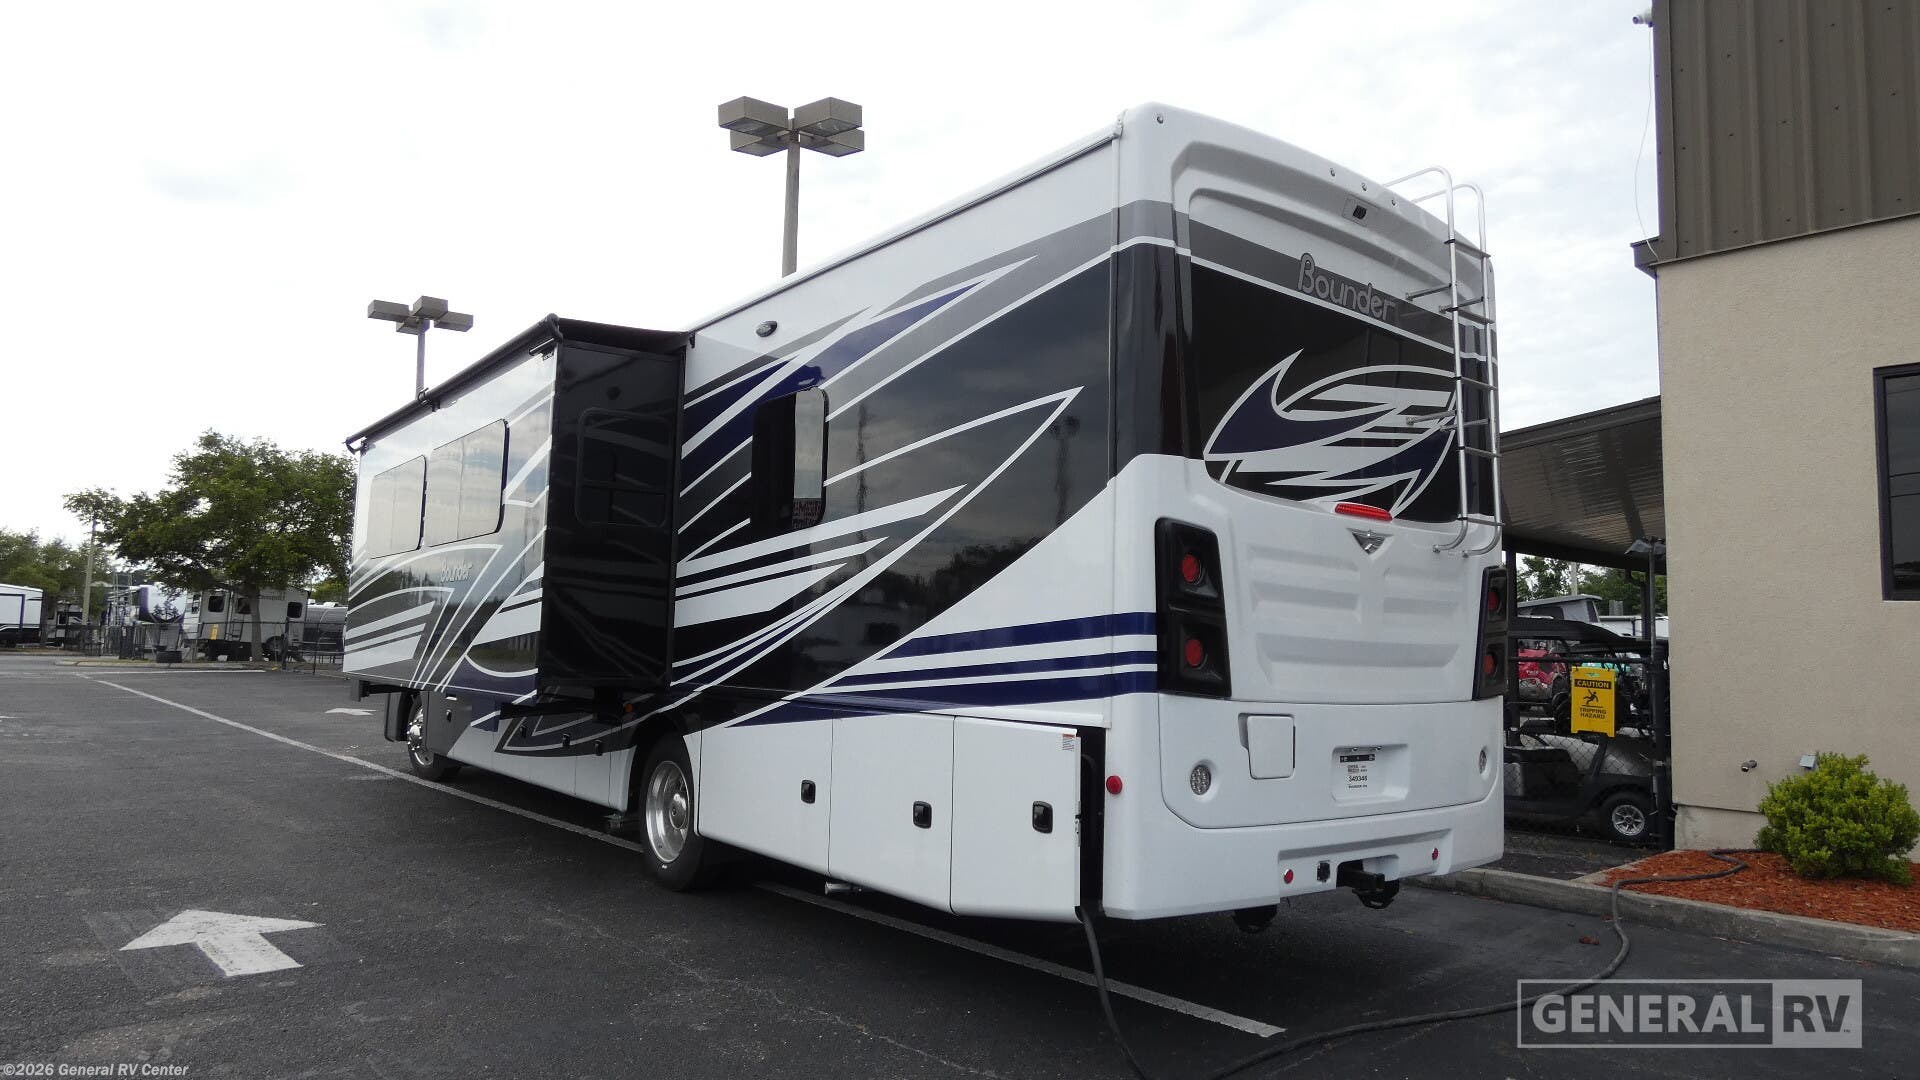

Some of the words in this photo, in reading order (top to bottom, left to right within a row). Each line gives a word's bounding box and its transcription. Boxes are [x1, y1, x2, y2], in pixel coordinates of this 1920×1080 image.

[1298, 253, 1396, 321] Bounder
[1576, 680, 1609, 688] CAUTION
[1580, 707, 1607, 715] TRIPPING
